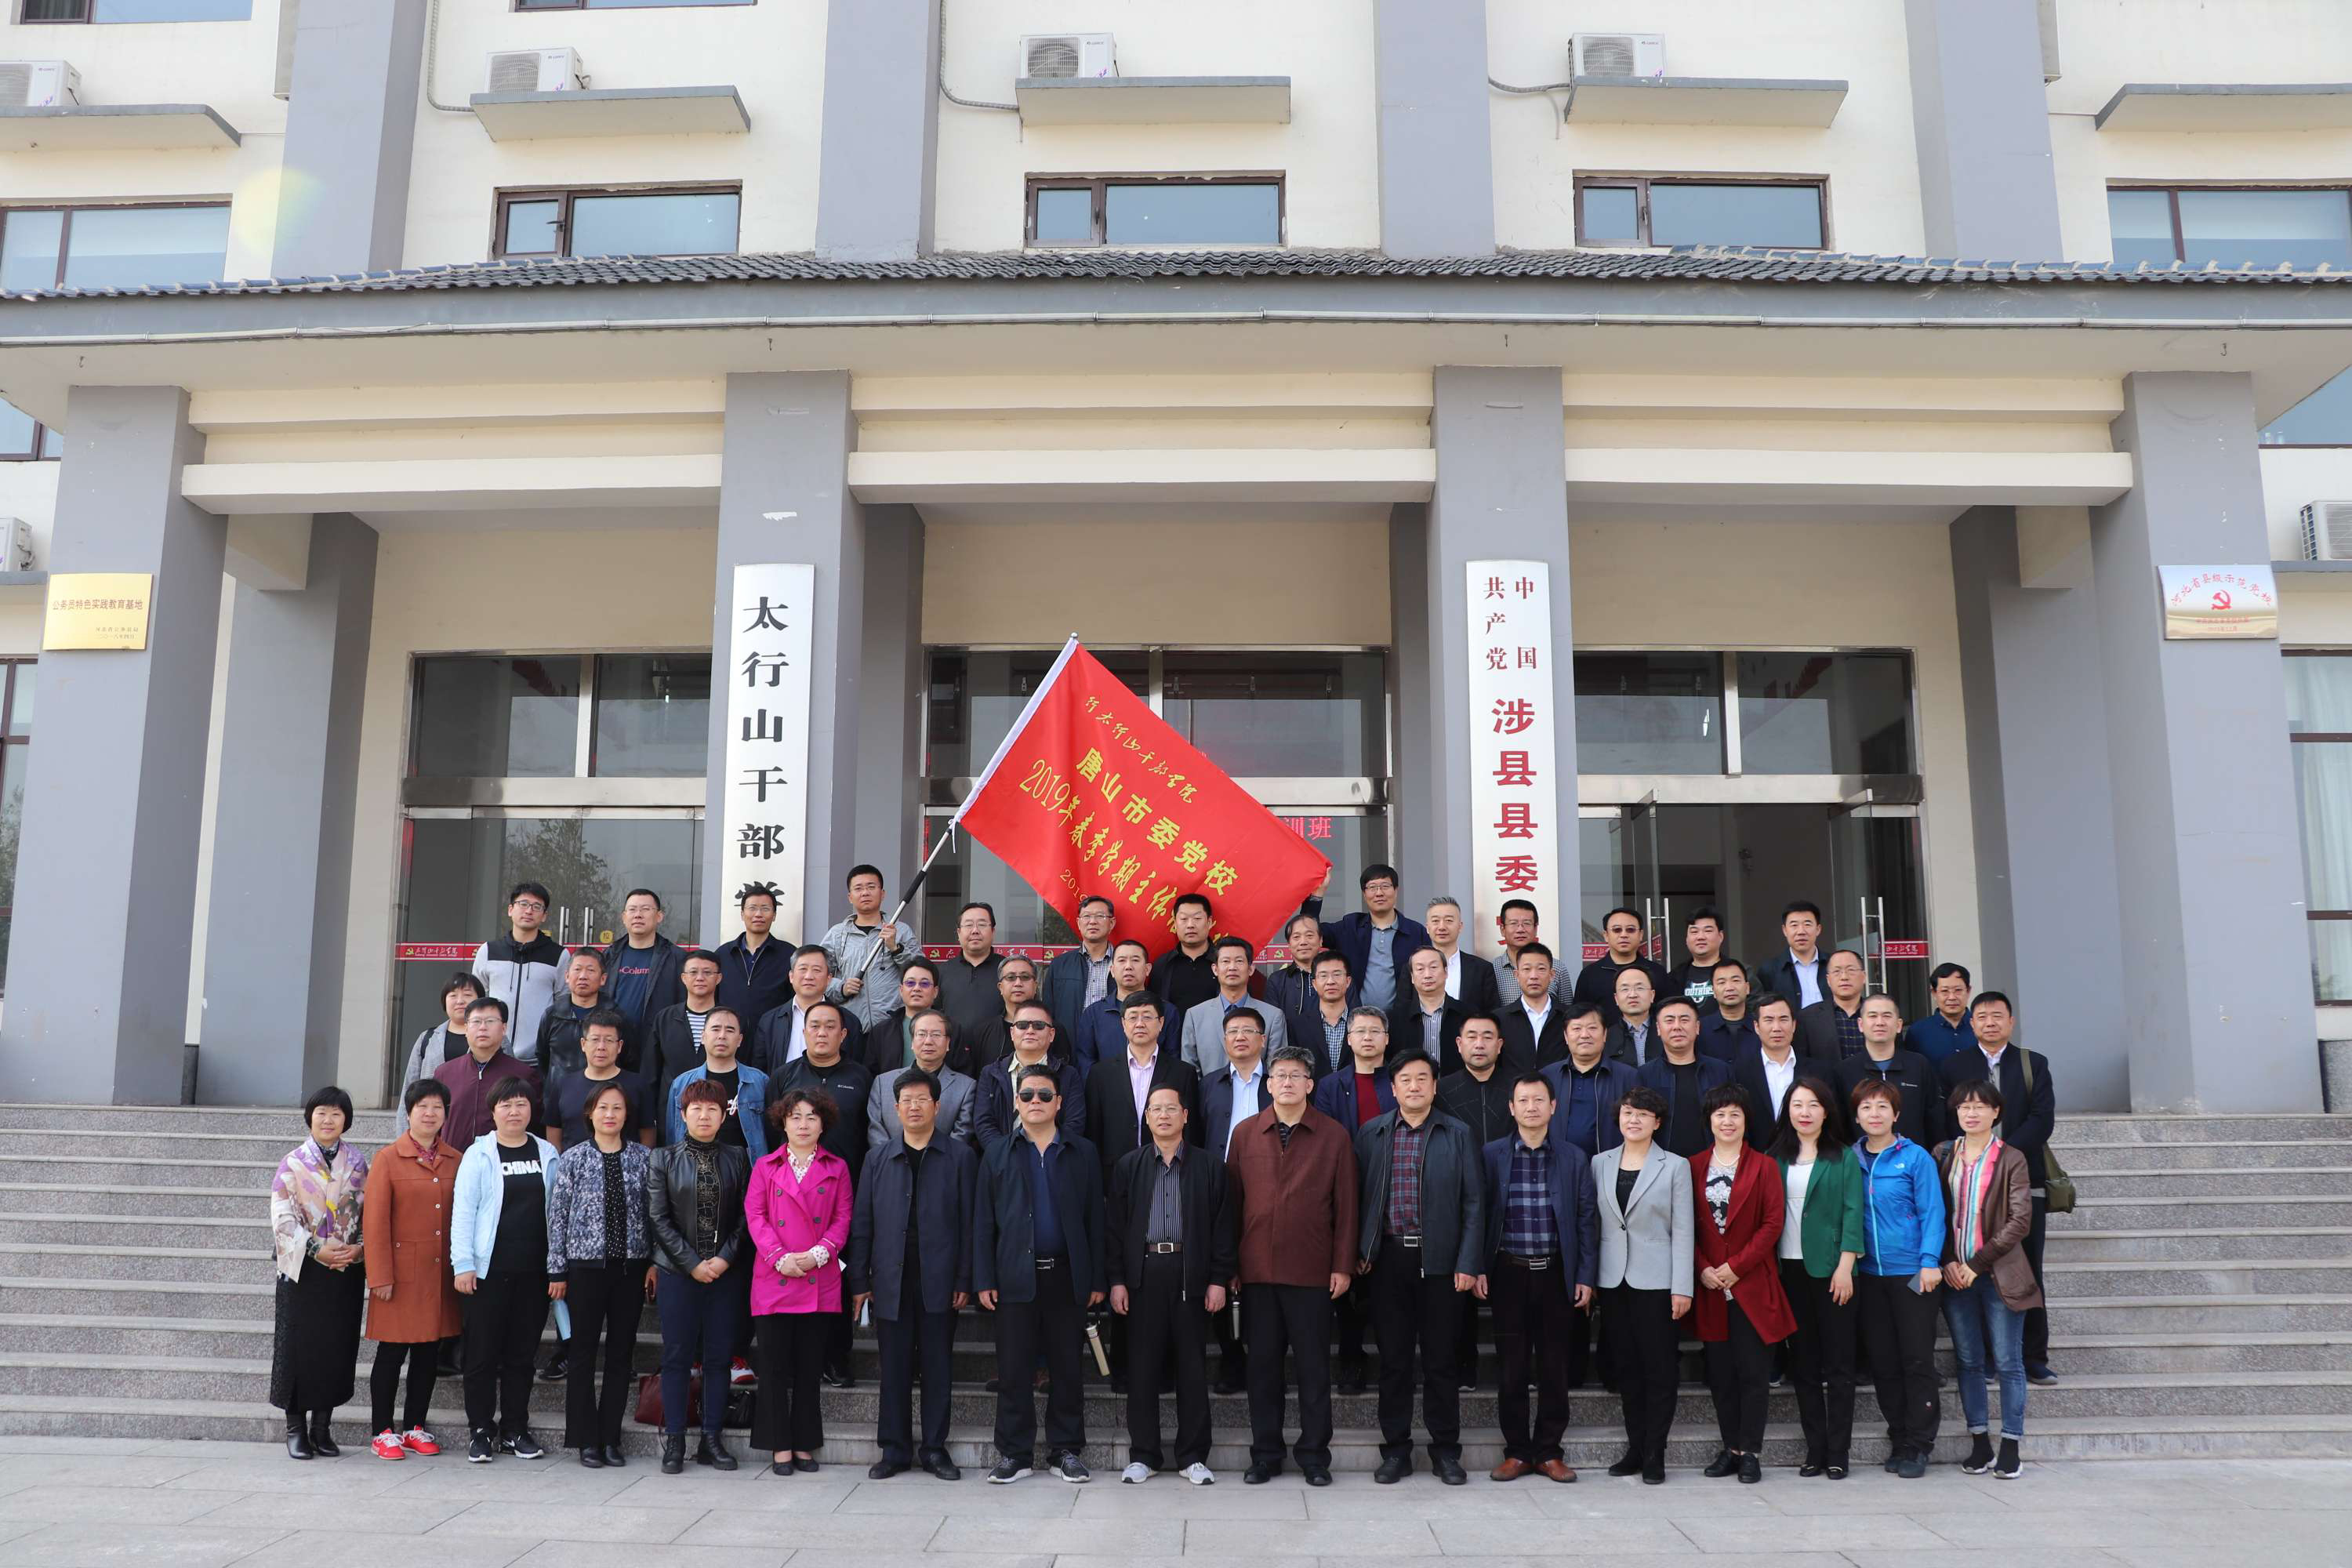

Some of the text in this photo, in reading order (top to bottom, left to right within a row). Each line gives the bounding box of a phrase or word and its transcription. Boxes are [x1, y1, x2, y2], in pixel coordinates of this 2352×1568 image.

[53, 599, 143, 610] 公务员特色实践教育基地
[1019, 759, 1215, 942] 2019年春季学期主体
[1076, 746, 1239, 896] 唐山市委党校
[1491, 698, 1540, 933] 涉县县委
[501, 1160, 543, 1175] CHINA
